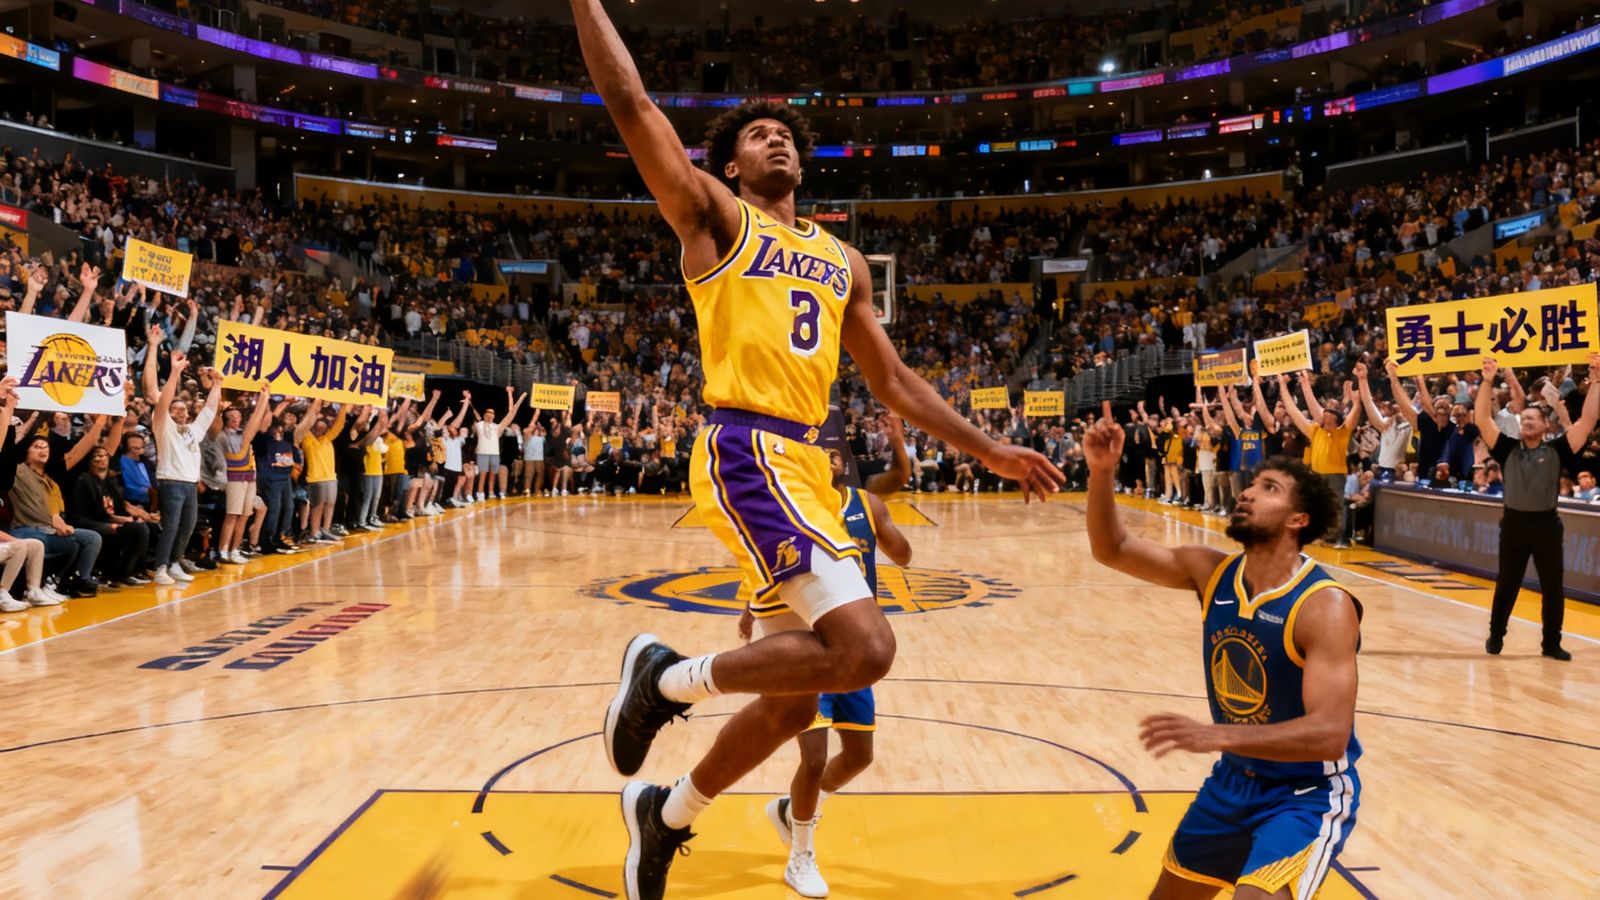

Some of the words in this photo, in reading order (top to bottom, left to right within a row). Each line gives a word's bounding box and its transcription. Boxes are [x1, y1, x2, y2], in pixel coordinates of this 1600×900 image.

[1395, 300, 1590, 365] 勇士必胜
[222, 333, 386, 398] 湖人加油
